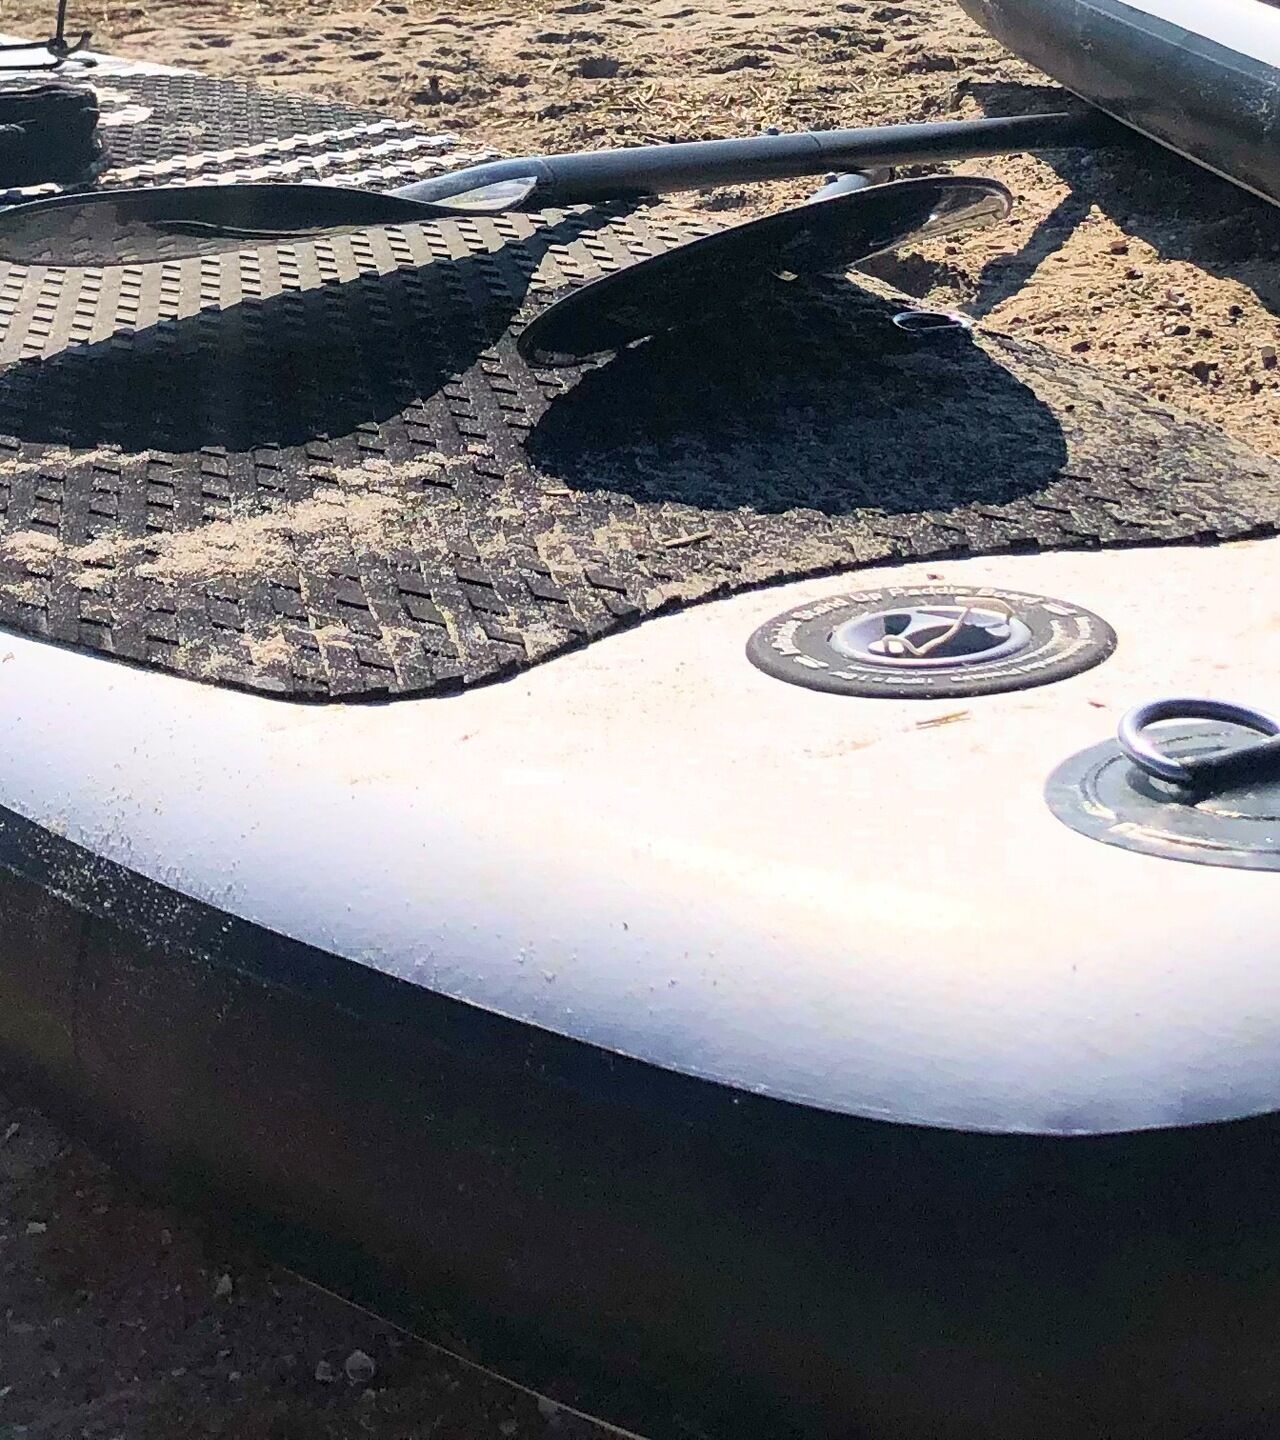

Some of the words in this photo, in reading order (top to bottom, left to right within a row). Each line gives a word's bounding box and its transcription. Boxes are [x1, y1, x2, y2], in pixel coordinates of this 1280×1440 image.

[791, 597, 850, 621] Stand
[848, 591, 883, 603] Up
[887, 585, 972, 599] Paddle
[975, 587, 1045, 605] Board
